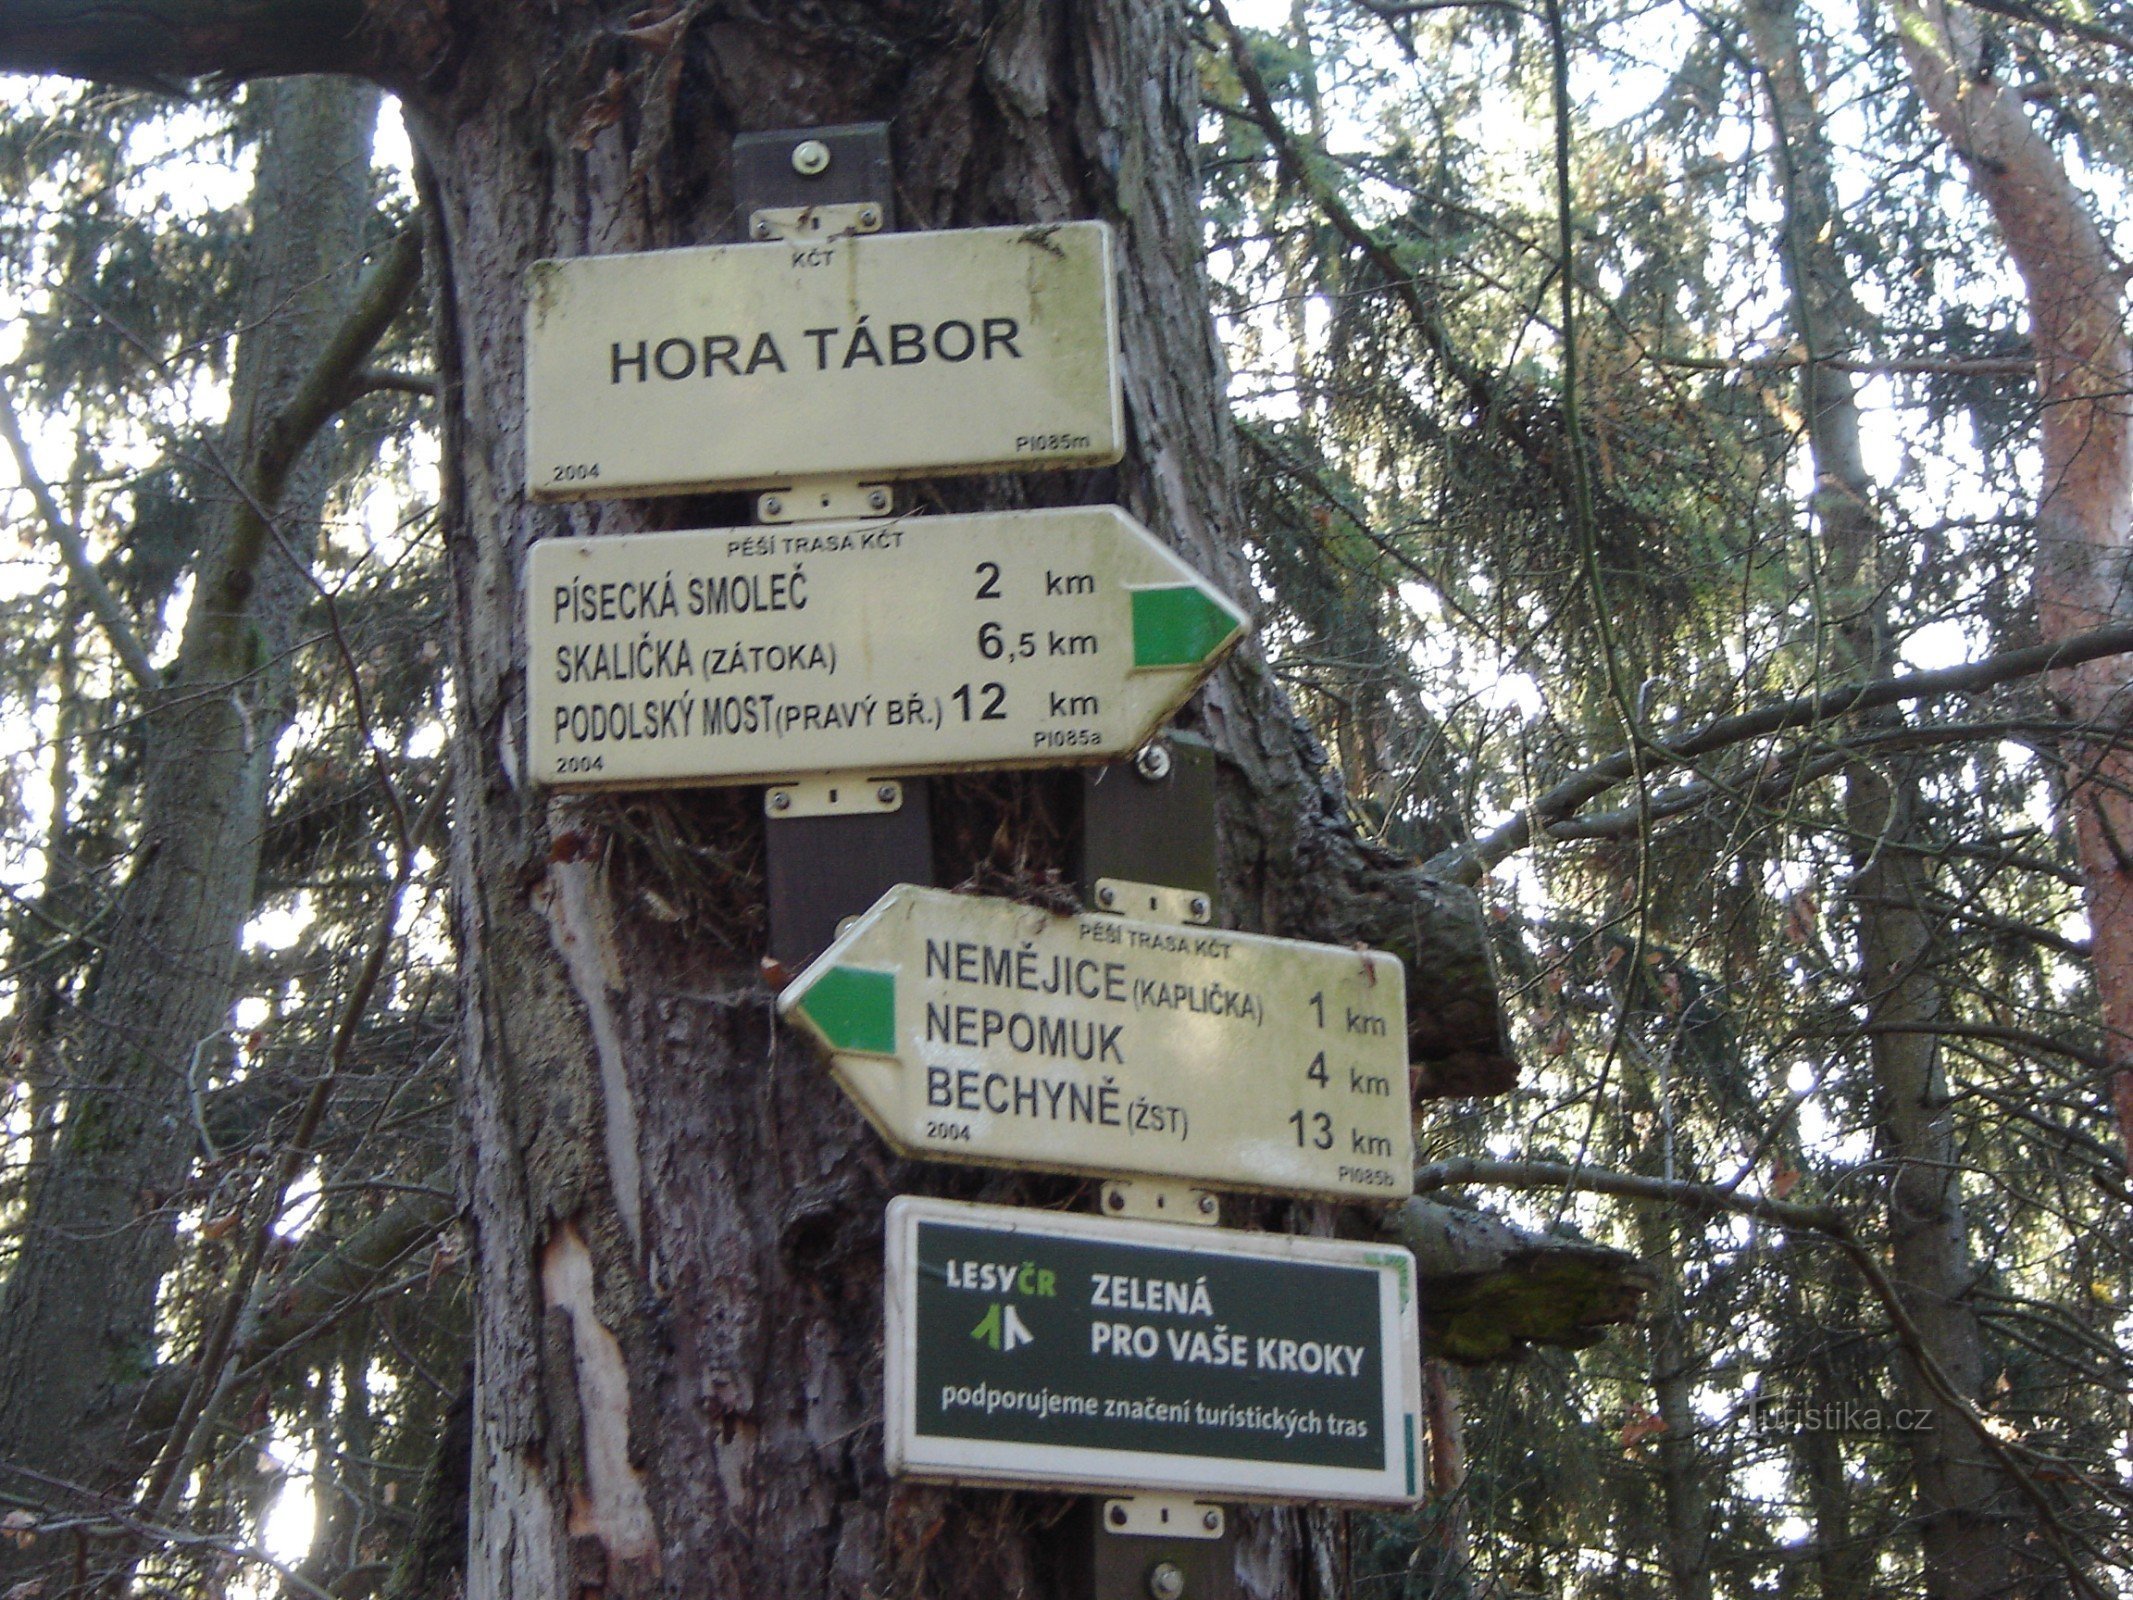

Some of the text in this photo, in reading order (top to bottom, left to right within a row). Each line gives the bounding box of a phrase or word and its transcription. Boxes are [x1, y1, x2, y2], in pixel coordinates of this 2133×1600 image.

[791, 249, 834, 268] KČT
[610, 314, 1022, 384] HORA TÁBOR
[552, 464, 601, 482] 2004
[781, 536, 853, 554] TRASA
[860, 529, 904, 550] KČT
[553, 561, 1095, 624] PÍSECKÁ SMOLEČ 2 km
[554, 621, 1098, 684] SKALIČKA (ZÁTOKA) 6,5 km
[554, 689, 695, 744] PODOLSKÝ
[951, 681, 1007, 722] 12
[1049, 690, 1098, 718] km
[555, 755, 604, 773] 2004
[1128, 929, 1190, 954] TRASA
[1194, 938, 1232, 960] KČT
[924, 938, 1387, 1038] NEMĚJICE (KAPLIČKA) 1 km
[925, 1001, 1390, 1097] NEPOMUK 4 km
[926, 1065, 1392, 1158] BECHYNĚ (ŽST) 13 km
[926, 1121, 972, 1142] 2004
[1091, 1273, 1214, 1318] ZELENÁ
[1091, 1321, 1365, 1377] PRO VAŠE KROKY
[941, 1381, 1368, 1439] podporujeme značení turistických tras
